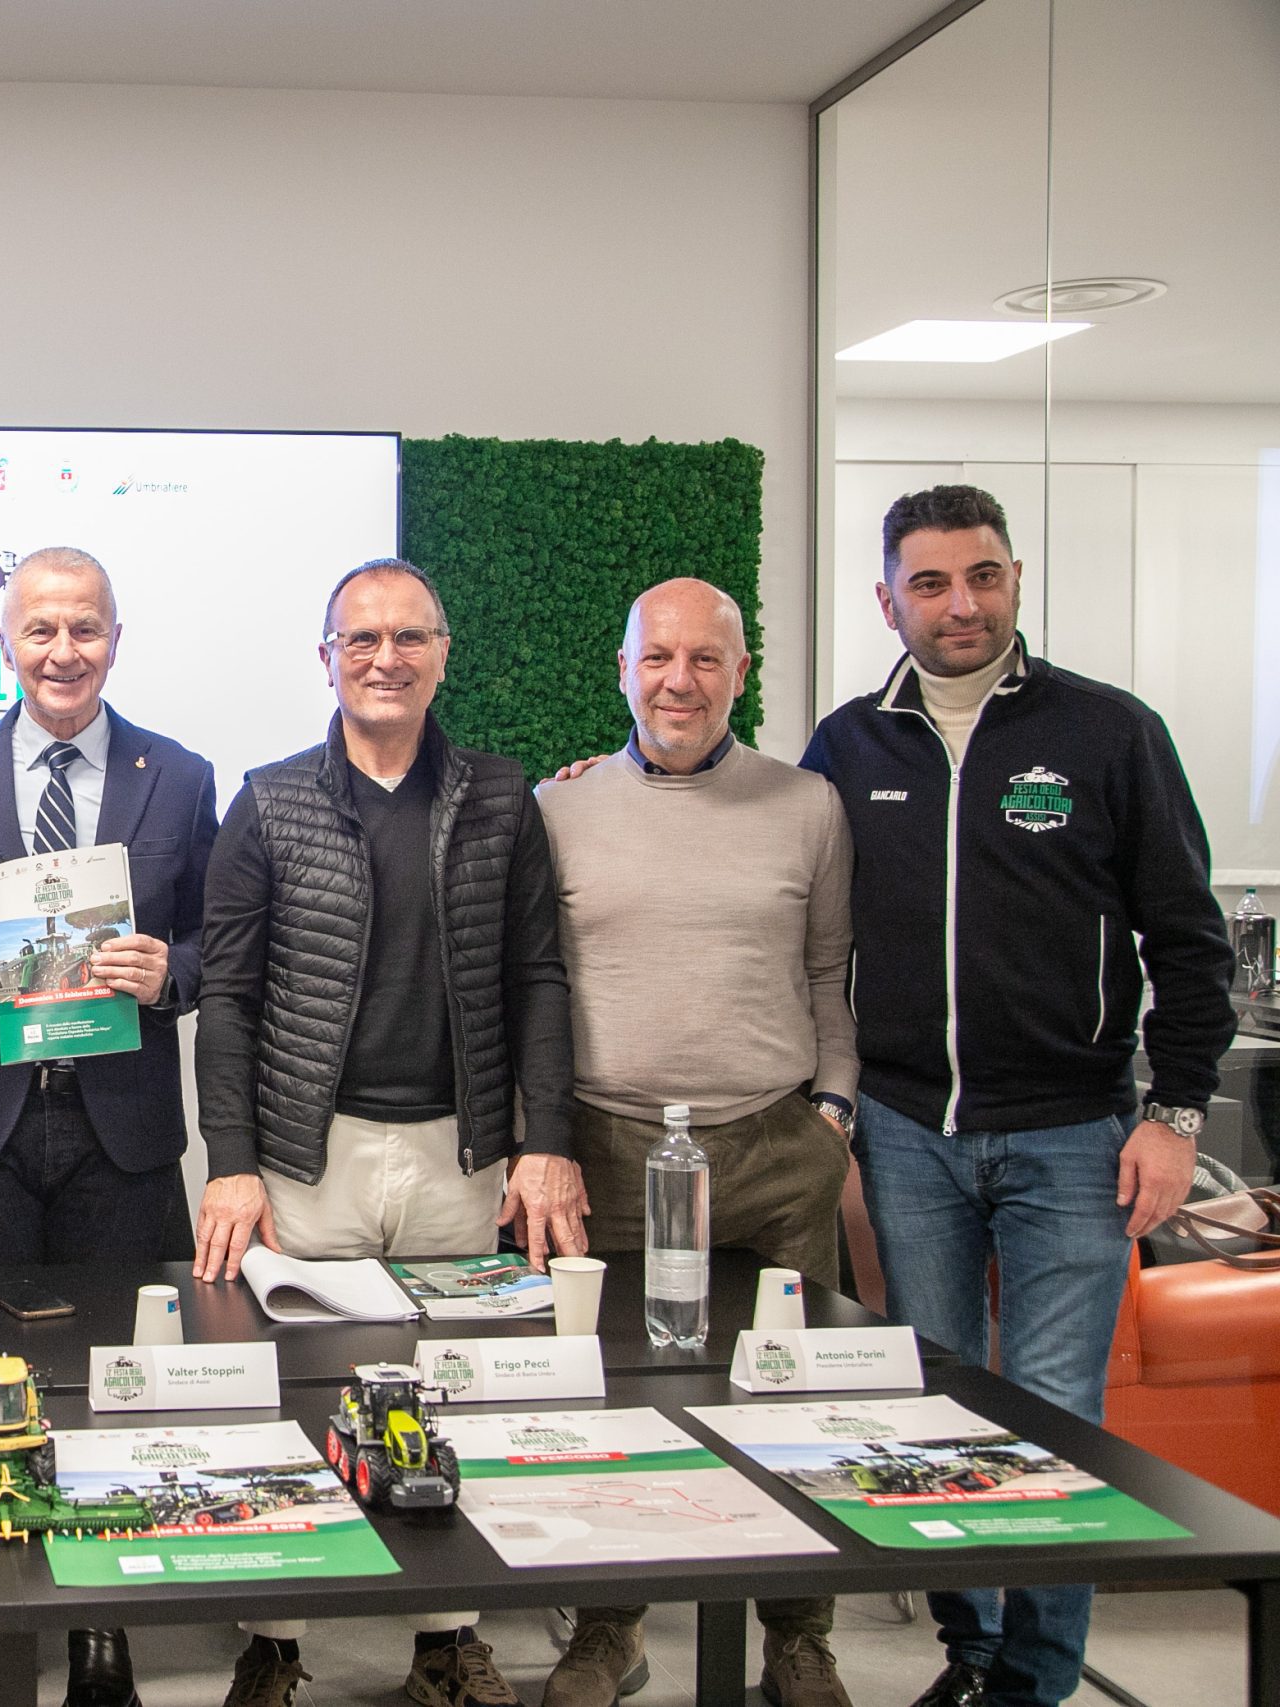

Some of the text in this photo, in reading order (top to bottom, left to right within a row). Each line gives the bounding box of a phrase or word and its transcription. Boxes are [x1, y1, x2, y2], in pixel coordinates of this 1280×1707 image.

[870, 790, 908, 801] GIANCARLO
[1013, 784, 1062, 796] FESTA DEGLI
[1000, 795, 1072, 813] AGRICOLTORI
[1025, 813, 1046, 821] ASSISI
[34, 889, 73, 903] AGRICOLTORI
[815, 1350, 886, 1360] Antonio Forini
[494, 1359, 550, 1371] Erigo Pecci
[756, 1359, 796, 1370] AGRICOLTORI
[114, 1368, 128, 1376] FESTA
[167, 1366, 245, 1378] Valter Stoppini
[433, 1368, 474, 1380] AGRICOLTORI
[104, 1376, 146, 1388] AGRICOLTORI
[131, 1452, 210, 1461] AGRICOLTORI
[540, 1453, 610, 1461] PERCORSO
[207, 1524, 268, 1533] febbraio
